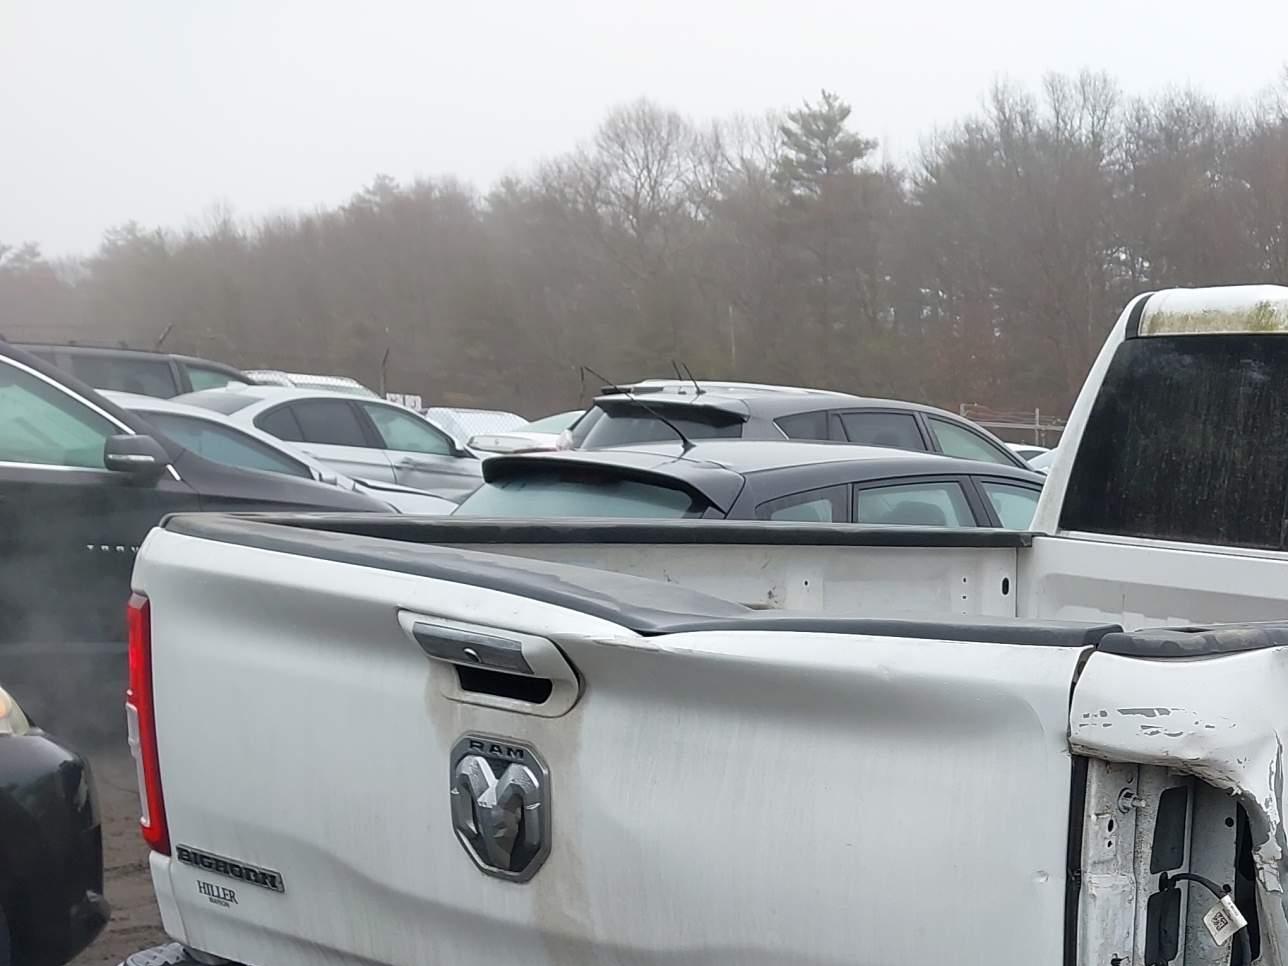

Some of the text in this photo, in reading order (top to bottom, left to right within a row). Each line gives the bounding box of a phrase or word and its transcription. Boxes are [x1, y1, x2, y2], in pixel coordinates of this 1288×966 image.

[468, 739, 525, 760] RAM
[176, 845, 281, 891] BIGHORN
[196, 879, 239, 905] HILLER
